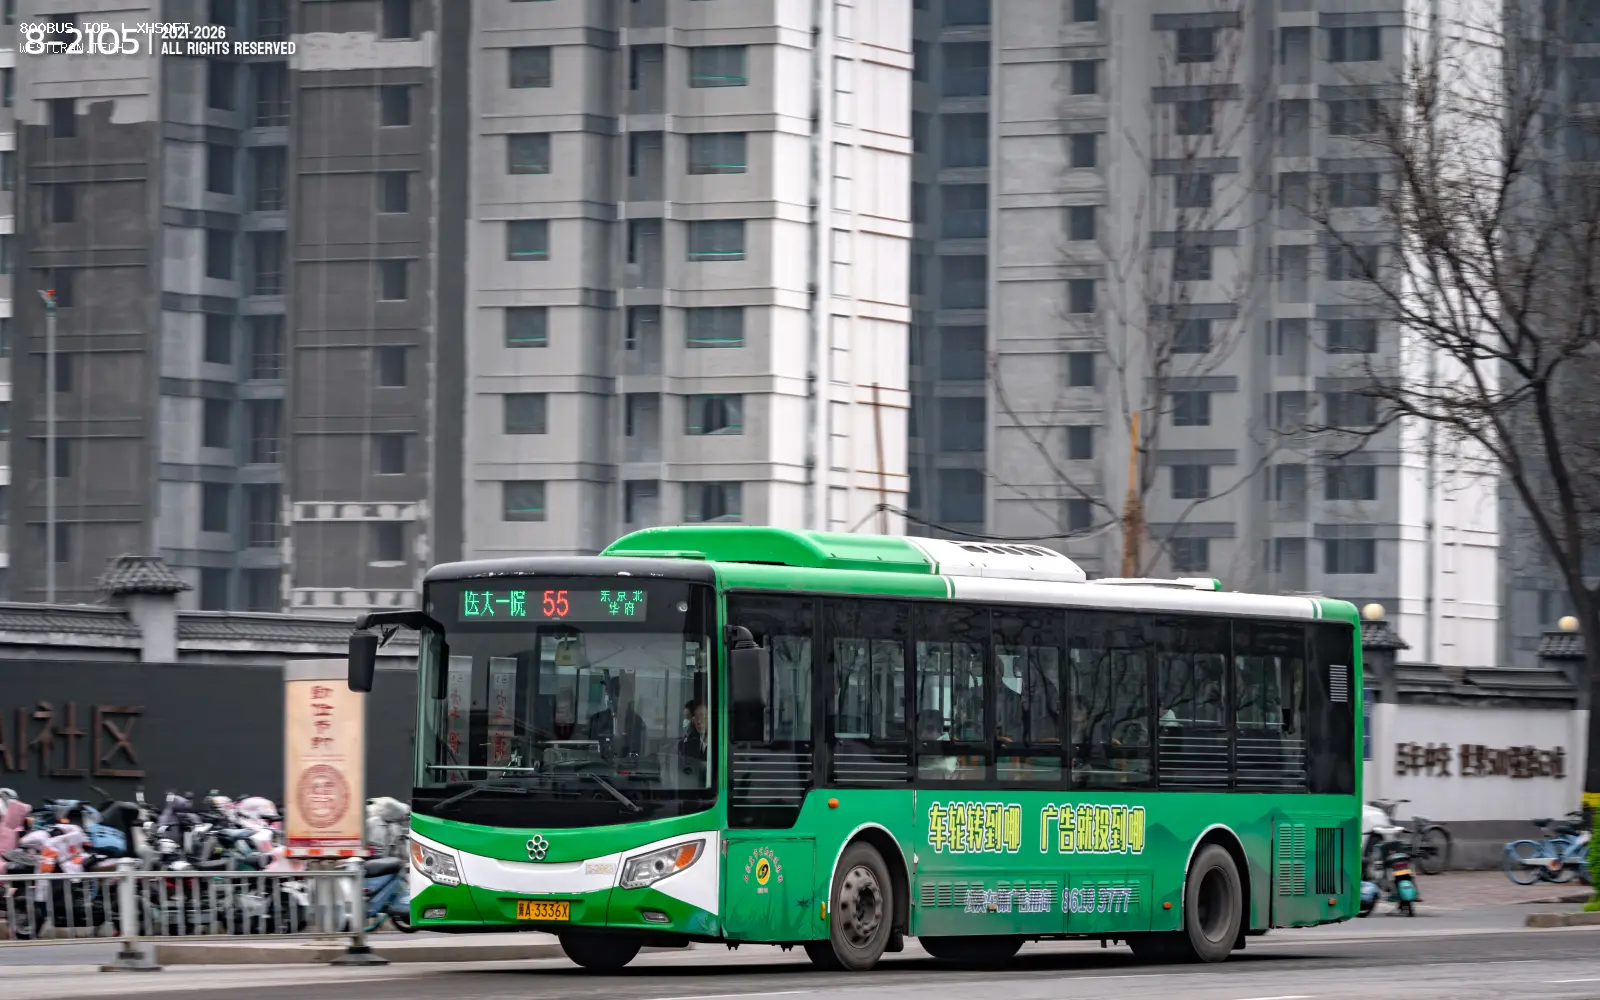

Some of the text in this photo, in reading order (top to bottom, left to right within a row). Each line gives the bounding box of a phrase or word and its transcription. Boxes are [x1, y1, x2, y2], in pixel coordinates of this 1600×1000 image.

[464, 590, 526, 617] 医大一院
[543, 590, 569, 617] 55
[600, 590, 643, 602] 东京北
[608, 602, 635, 616] 华府
[929, 803, 1145, 853] 车轮转到哪 广告就投到哪
